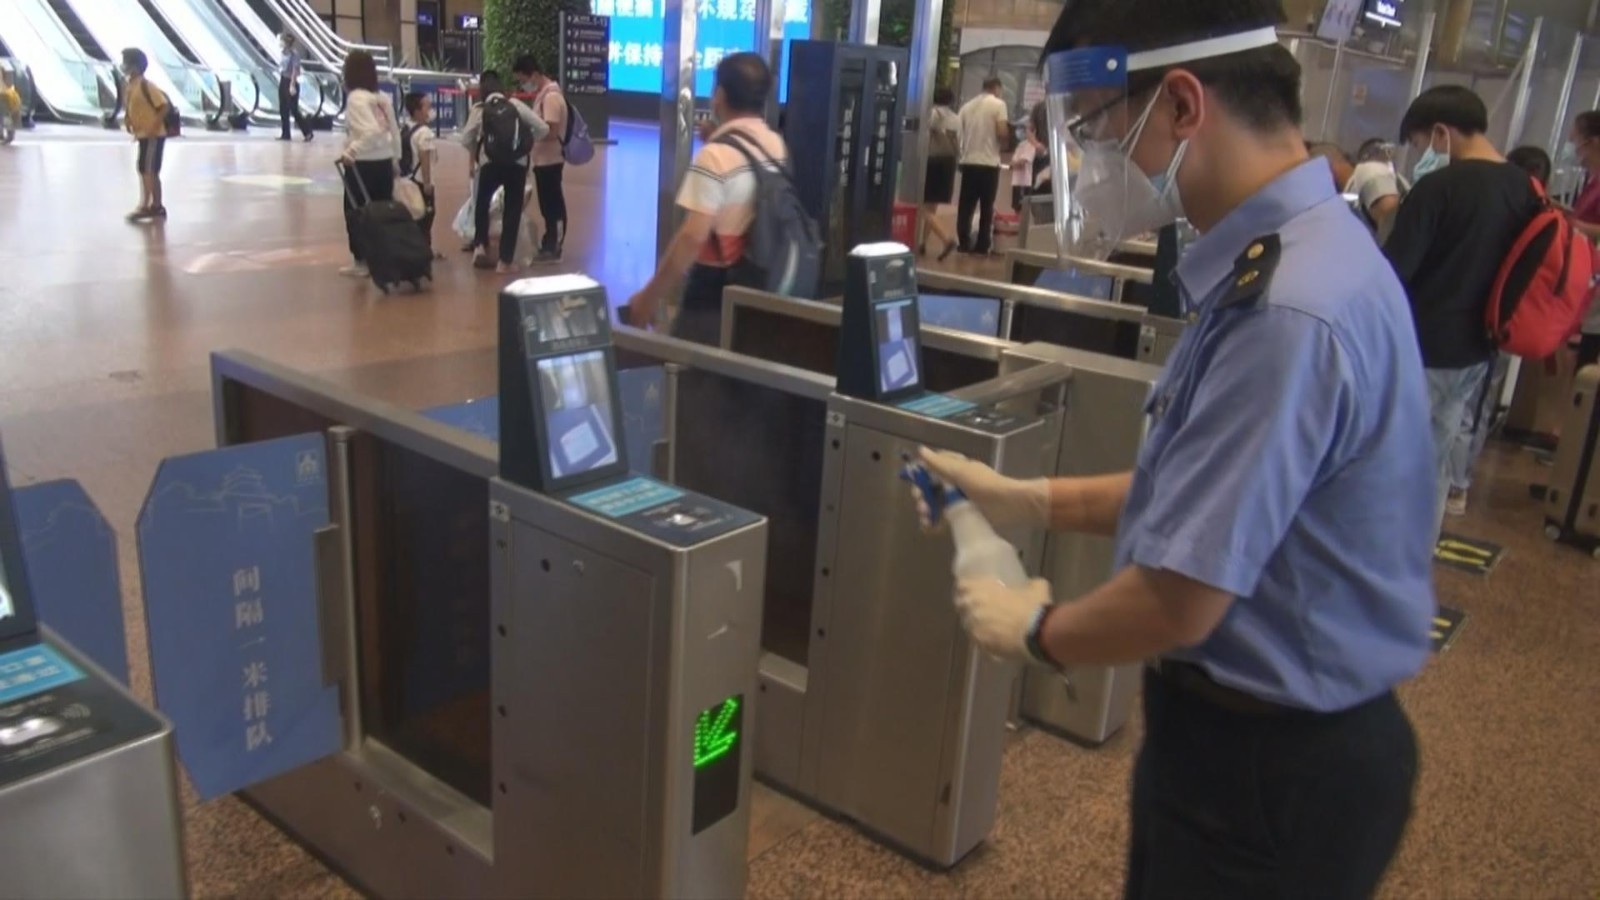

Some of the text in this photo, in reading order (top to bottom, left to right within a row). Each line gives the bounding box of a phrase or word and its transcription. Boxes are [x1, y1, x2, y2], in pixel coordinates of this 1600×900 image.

[232, 565, 273, 751] 间隔一米排队
